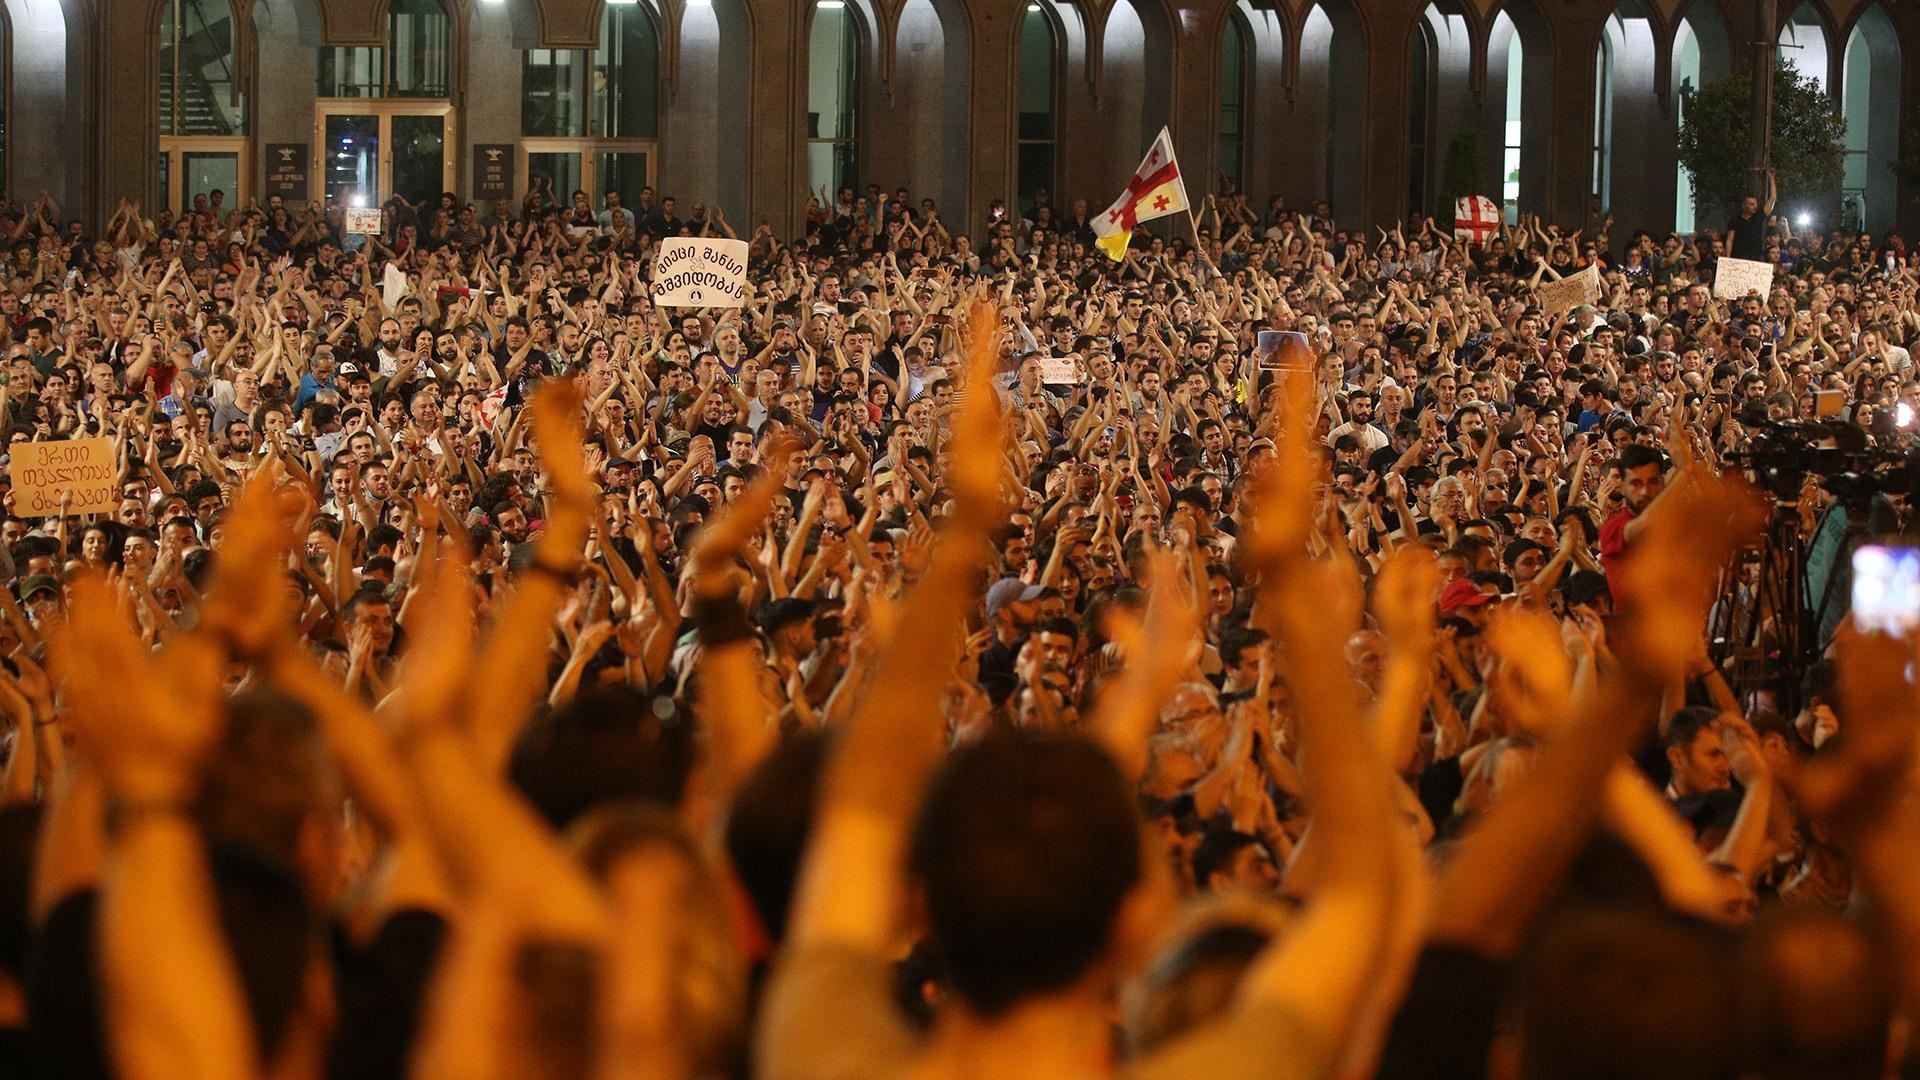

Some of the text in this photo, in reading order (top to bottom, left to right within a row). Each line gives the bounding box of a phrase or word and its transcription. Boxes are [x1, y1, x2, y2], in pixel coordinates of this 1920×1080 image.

[657, 245, 744, 276] მიეცი შანსი
[656, 271, 743, 299] მშვიდობას
[38, 445, 90, 467] ერთი
[31, 484, 116, 511] გხეავთ!
